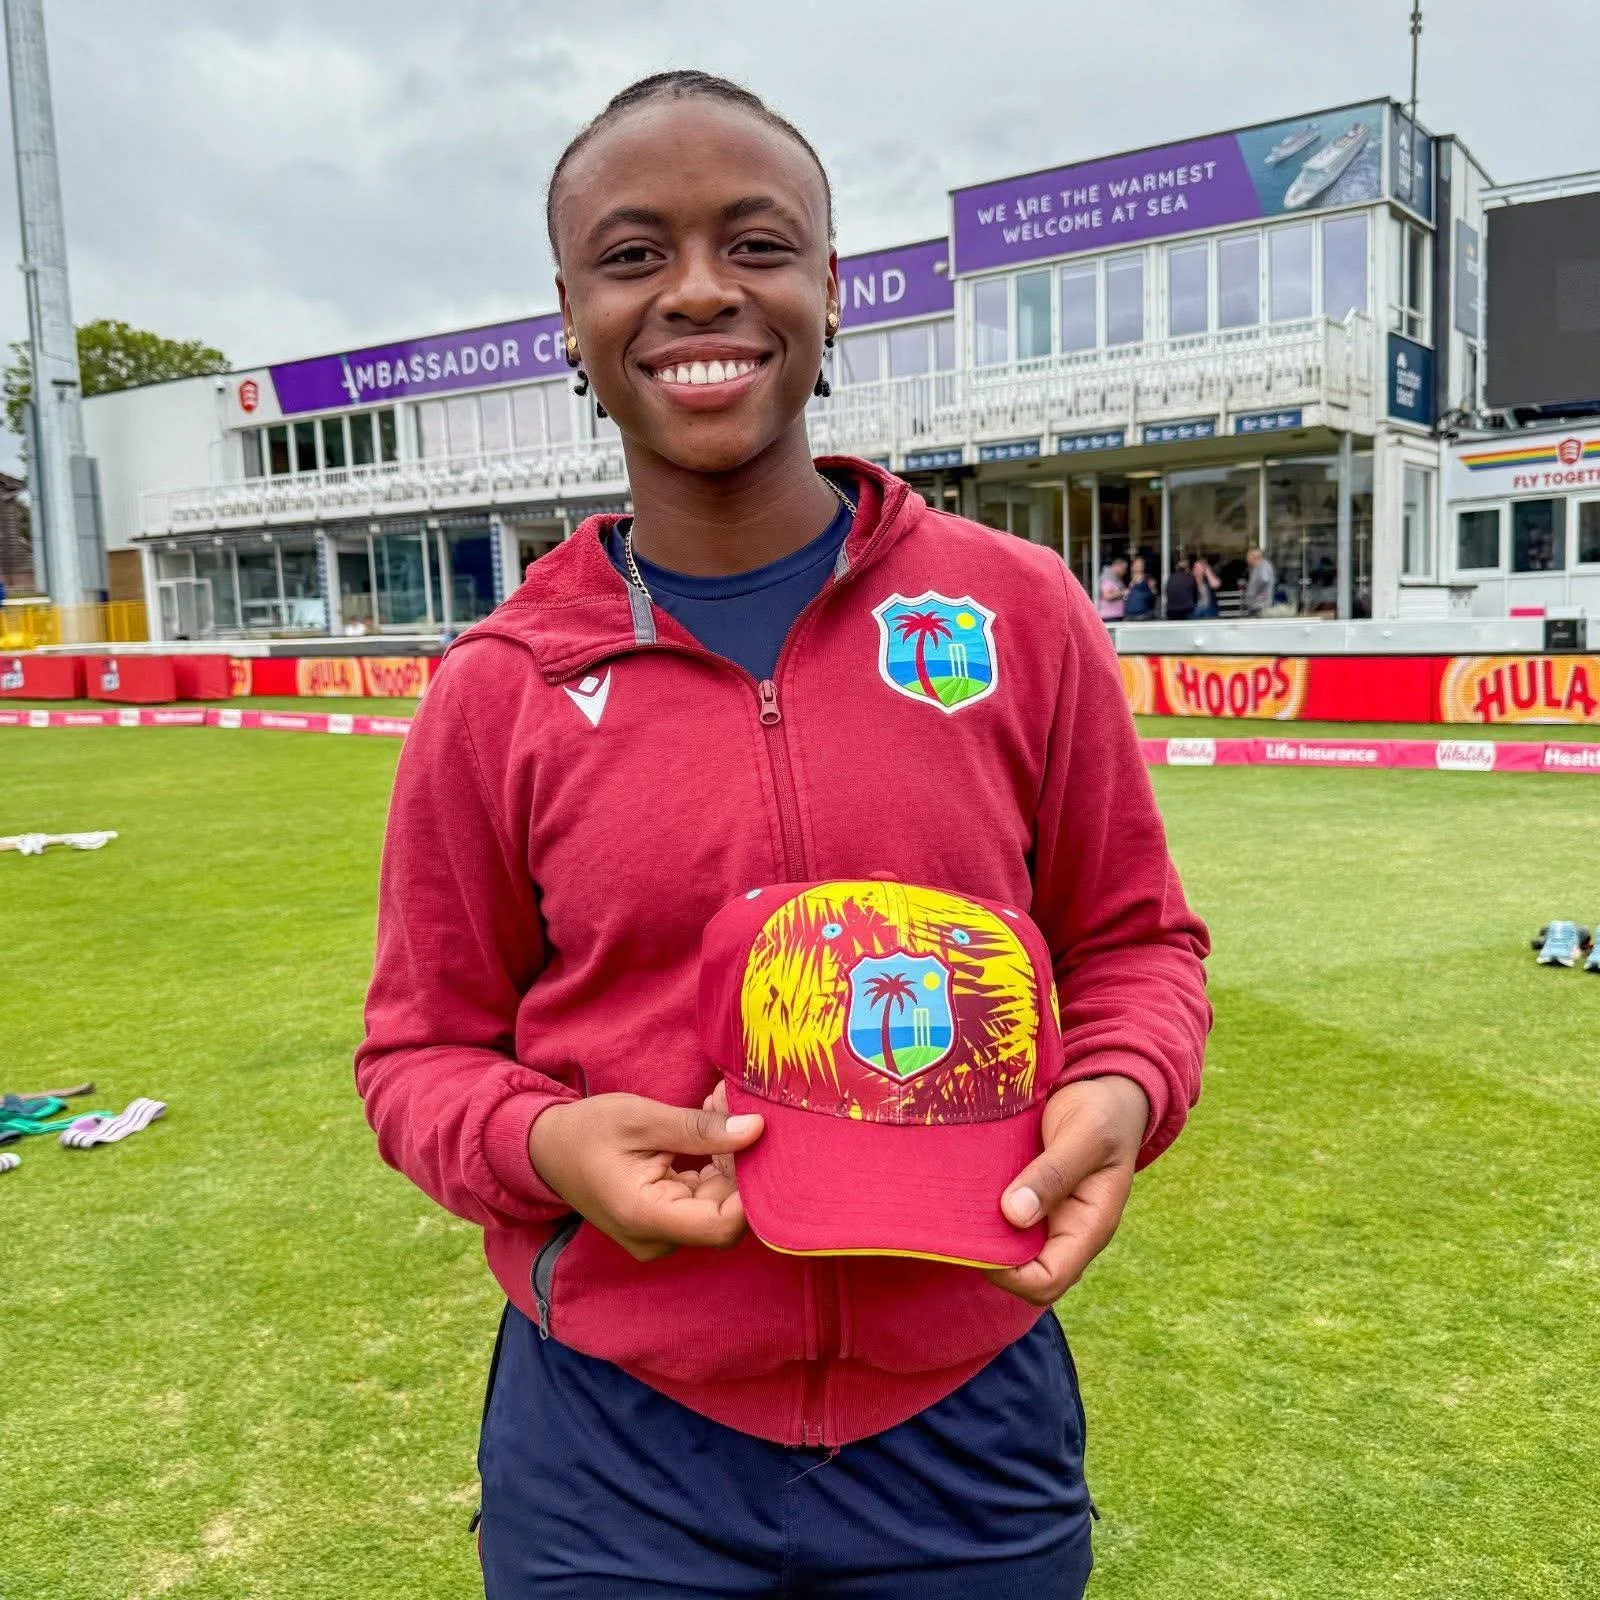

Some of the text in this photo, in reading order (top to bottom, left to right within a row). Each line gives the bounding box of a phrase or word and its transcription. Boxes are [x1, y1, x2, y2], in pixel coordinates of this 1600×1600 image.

[977, 161, 1217, 225] WE ARE THE WARMEST
[1002, 194, 1189, 244] WELCOME AT SEA
[341, 339, 521, 399] AMBASSADOR
[1513, 474, 1538, 488] FLY
[1177, 656, 1290, 717] HOOPS
[1474, 660, 1598, 723] HULA
[1265, 743, 1297, 760] Life
